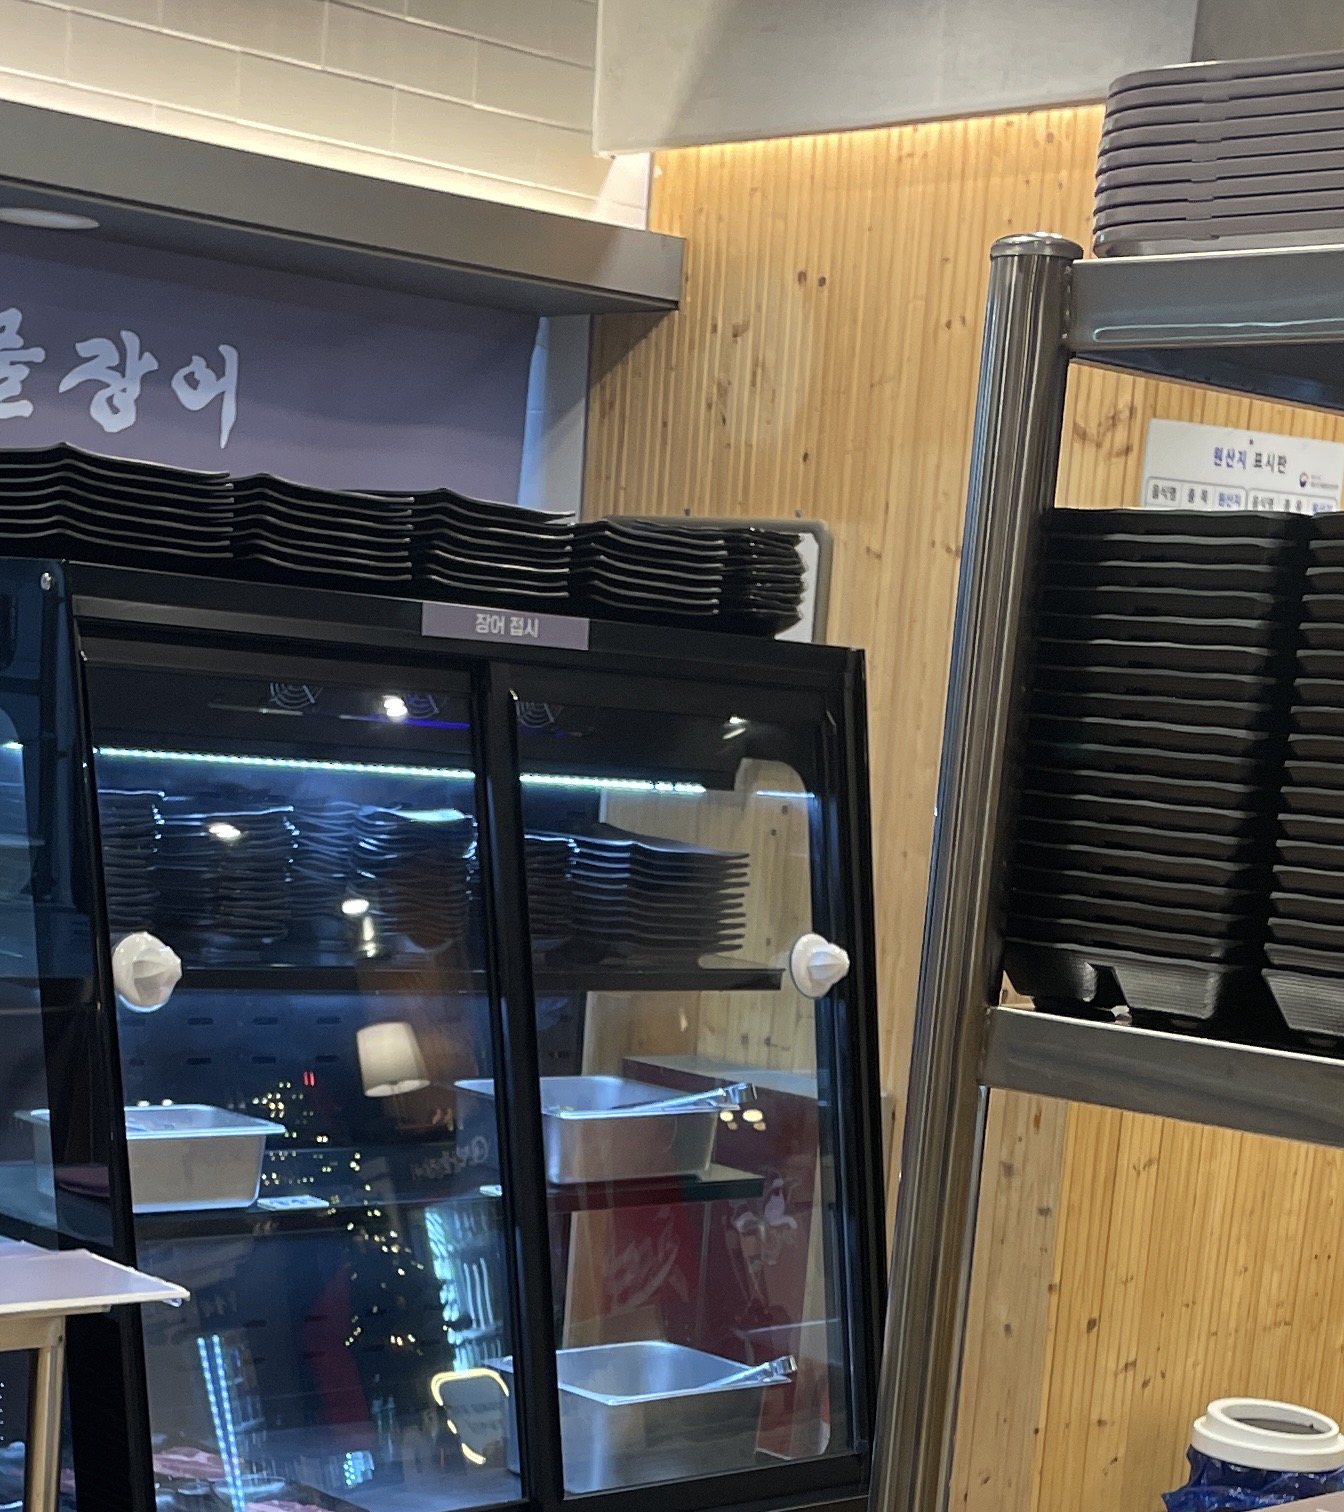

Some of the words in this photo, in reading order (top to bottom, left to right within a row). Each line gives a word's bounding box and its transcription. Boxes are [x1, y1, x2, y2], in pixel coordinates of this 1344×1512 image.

[1213, 446, 1247, 470] 원산지
[1253, 452, 1287, 474] 표시판
[475, 613, 505, 635] 장어
[509, 616, 539, 637] 접시
